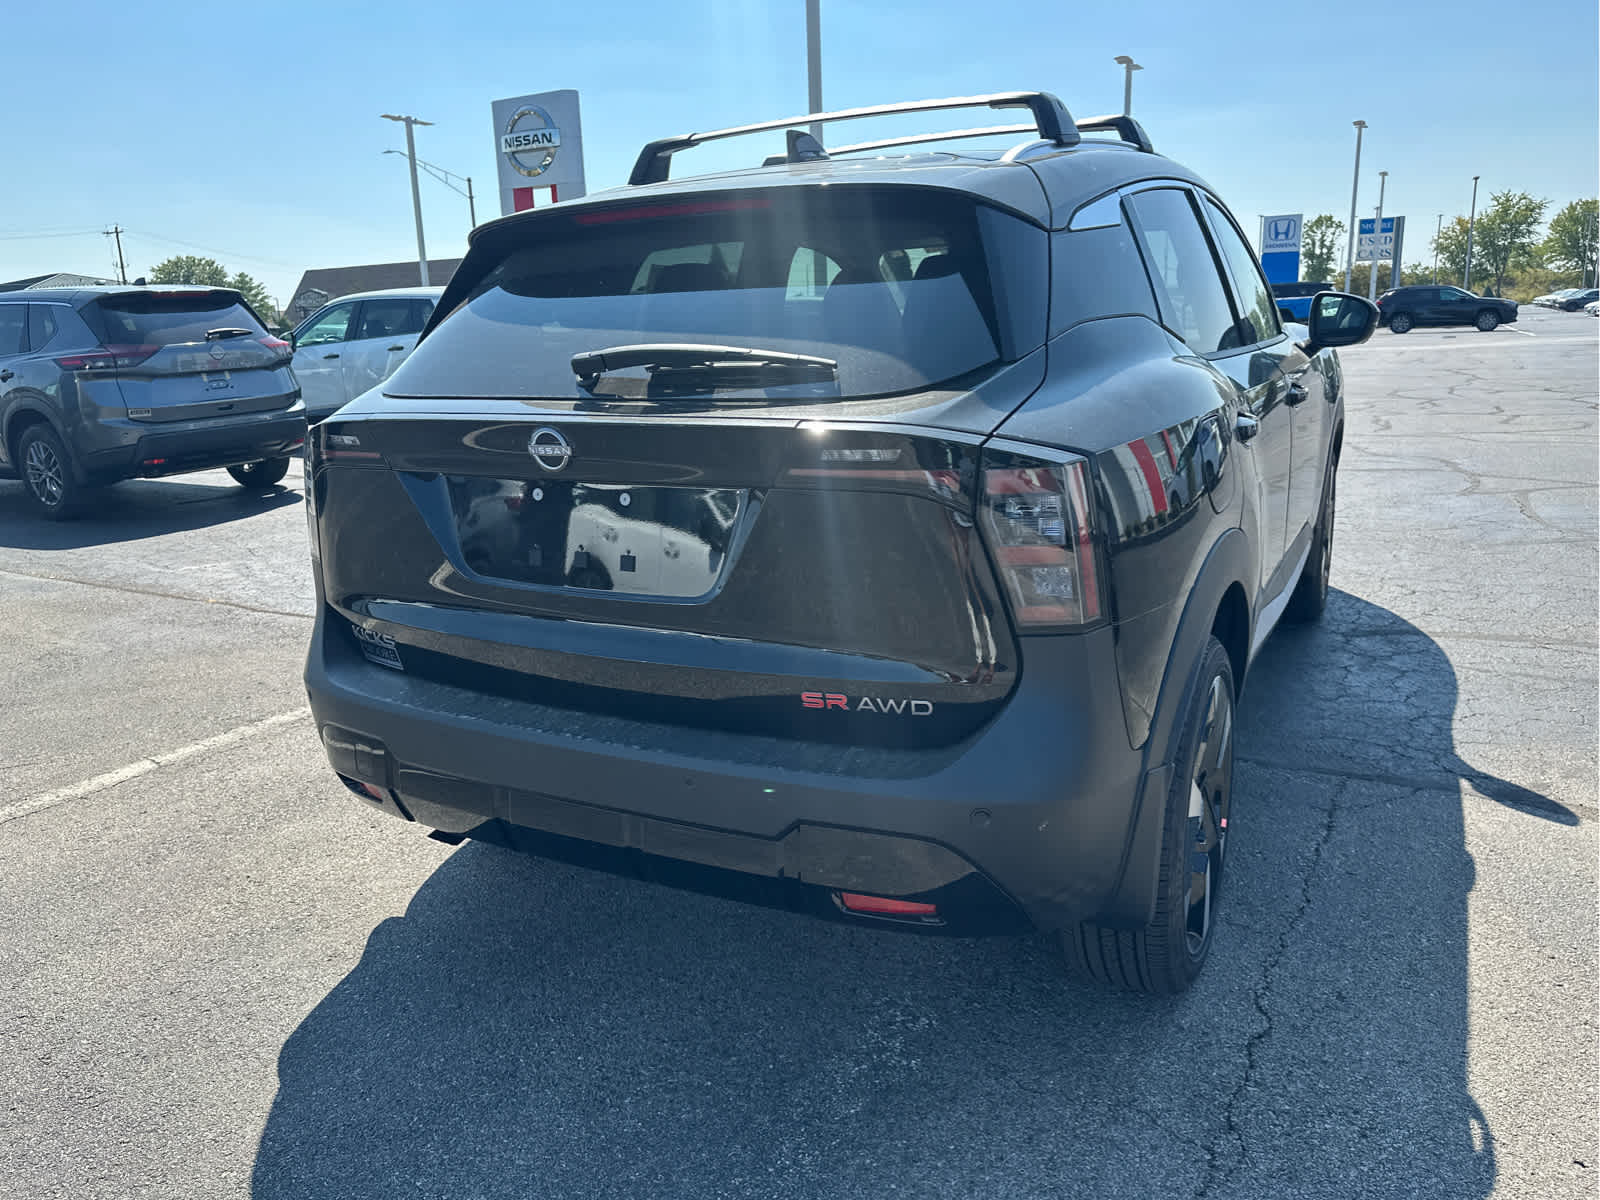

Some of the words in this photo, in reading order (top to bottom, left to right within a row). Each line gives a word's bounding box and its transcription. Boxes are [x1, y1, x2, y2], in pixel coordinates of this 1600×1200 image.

[504, 132, 553, 149] NISSAN
[1361, 221, 1393, 230] MORE
[1359, 235, 1393, 247] USD
[529, 446, 571, 456] NISSAN
[351, 624, 396, 648] KICKS
[801, 691, 849, 711] SR
[856, 697, 933, 716] AWD
